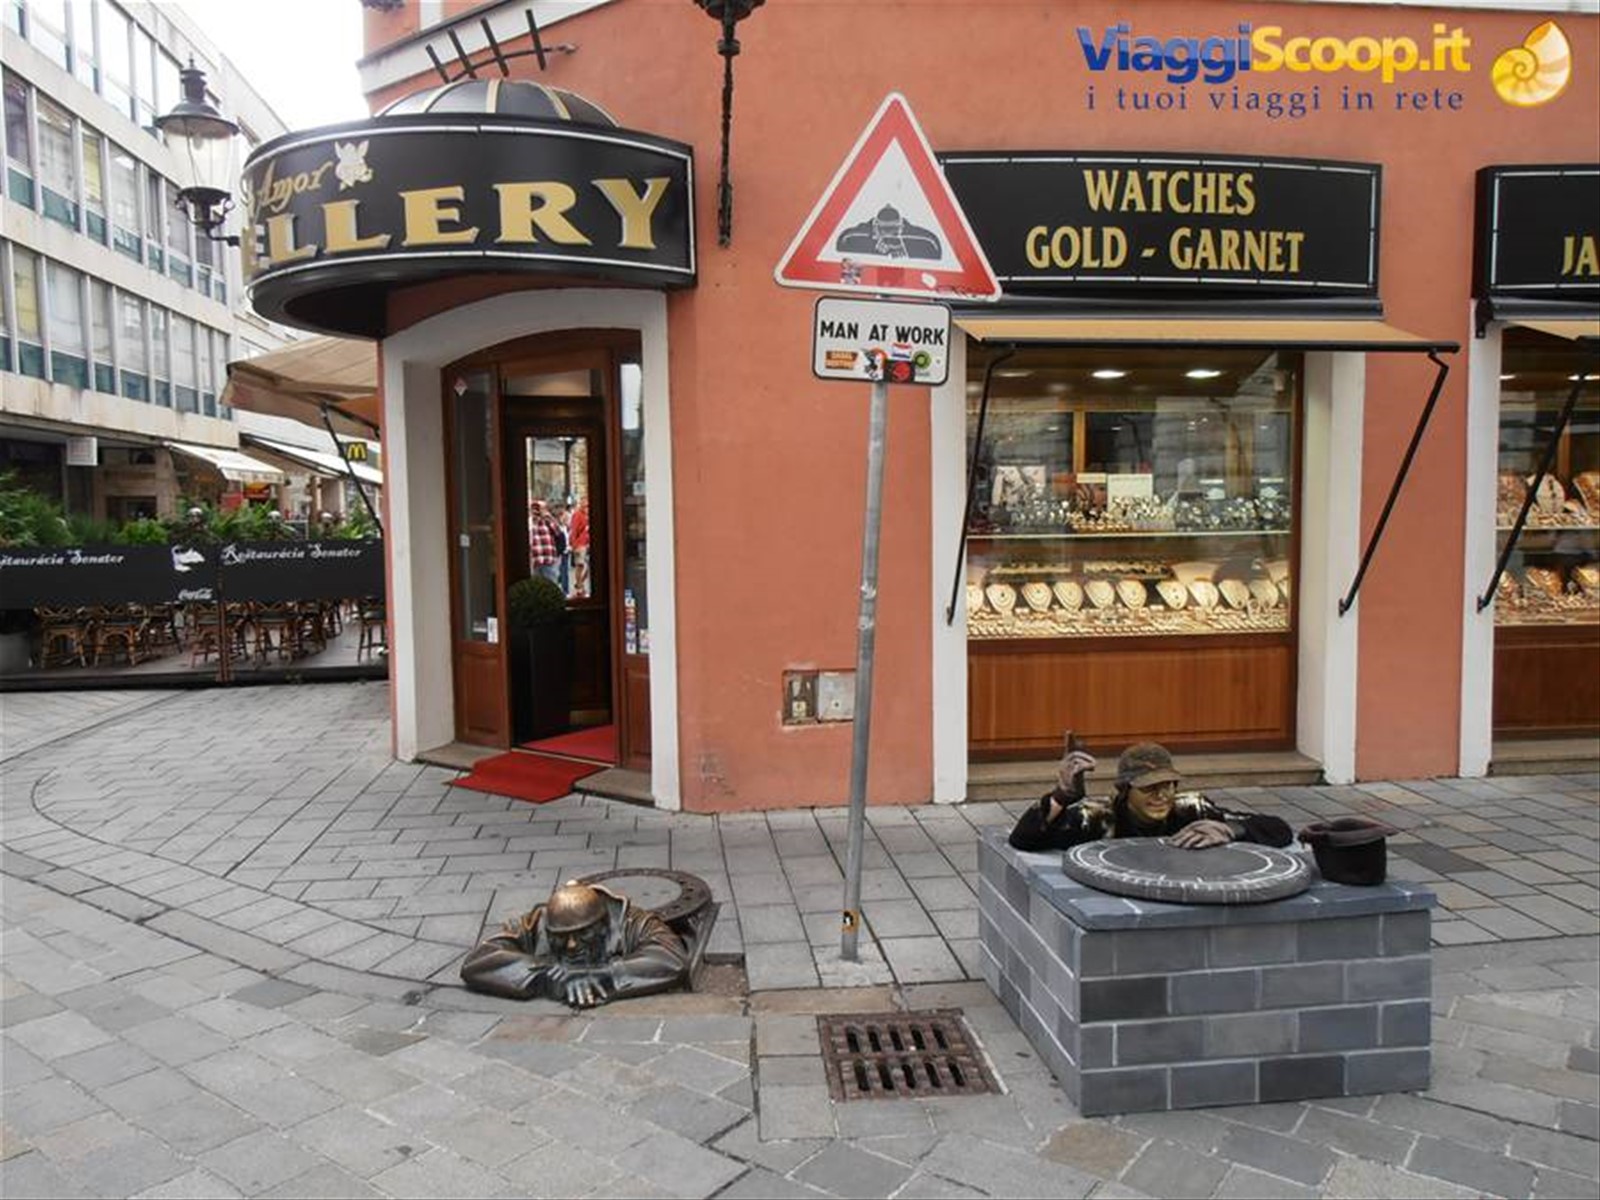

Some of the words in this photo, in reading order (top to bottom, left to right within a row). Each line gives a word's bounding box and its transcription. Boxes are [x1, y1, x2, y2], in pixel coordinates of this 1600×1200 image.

[1083, 169, 1257, 215] WATCHES
[1025, 225, 1128, 270] GOLD
[1169, 227, 1305, 273] GARNET
[1561, 236, 1600, 276] JA
[820, 320, 859, 340] MAN
[868, 324, 889, 342] AT
[895, 326, 945, 346] WORK
